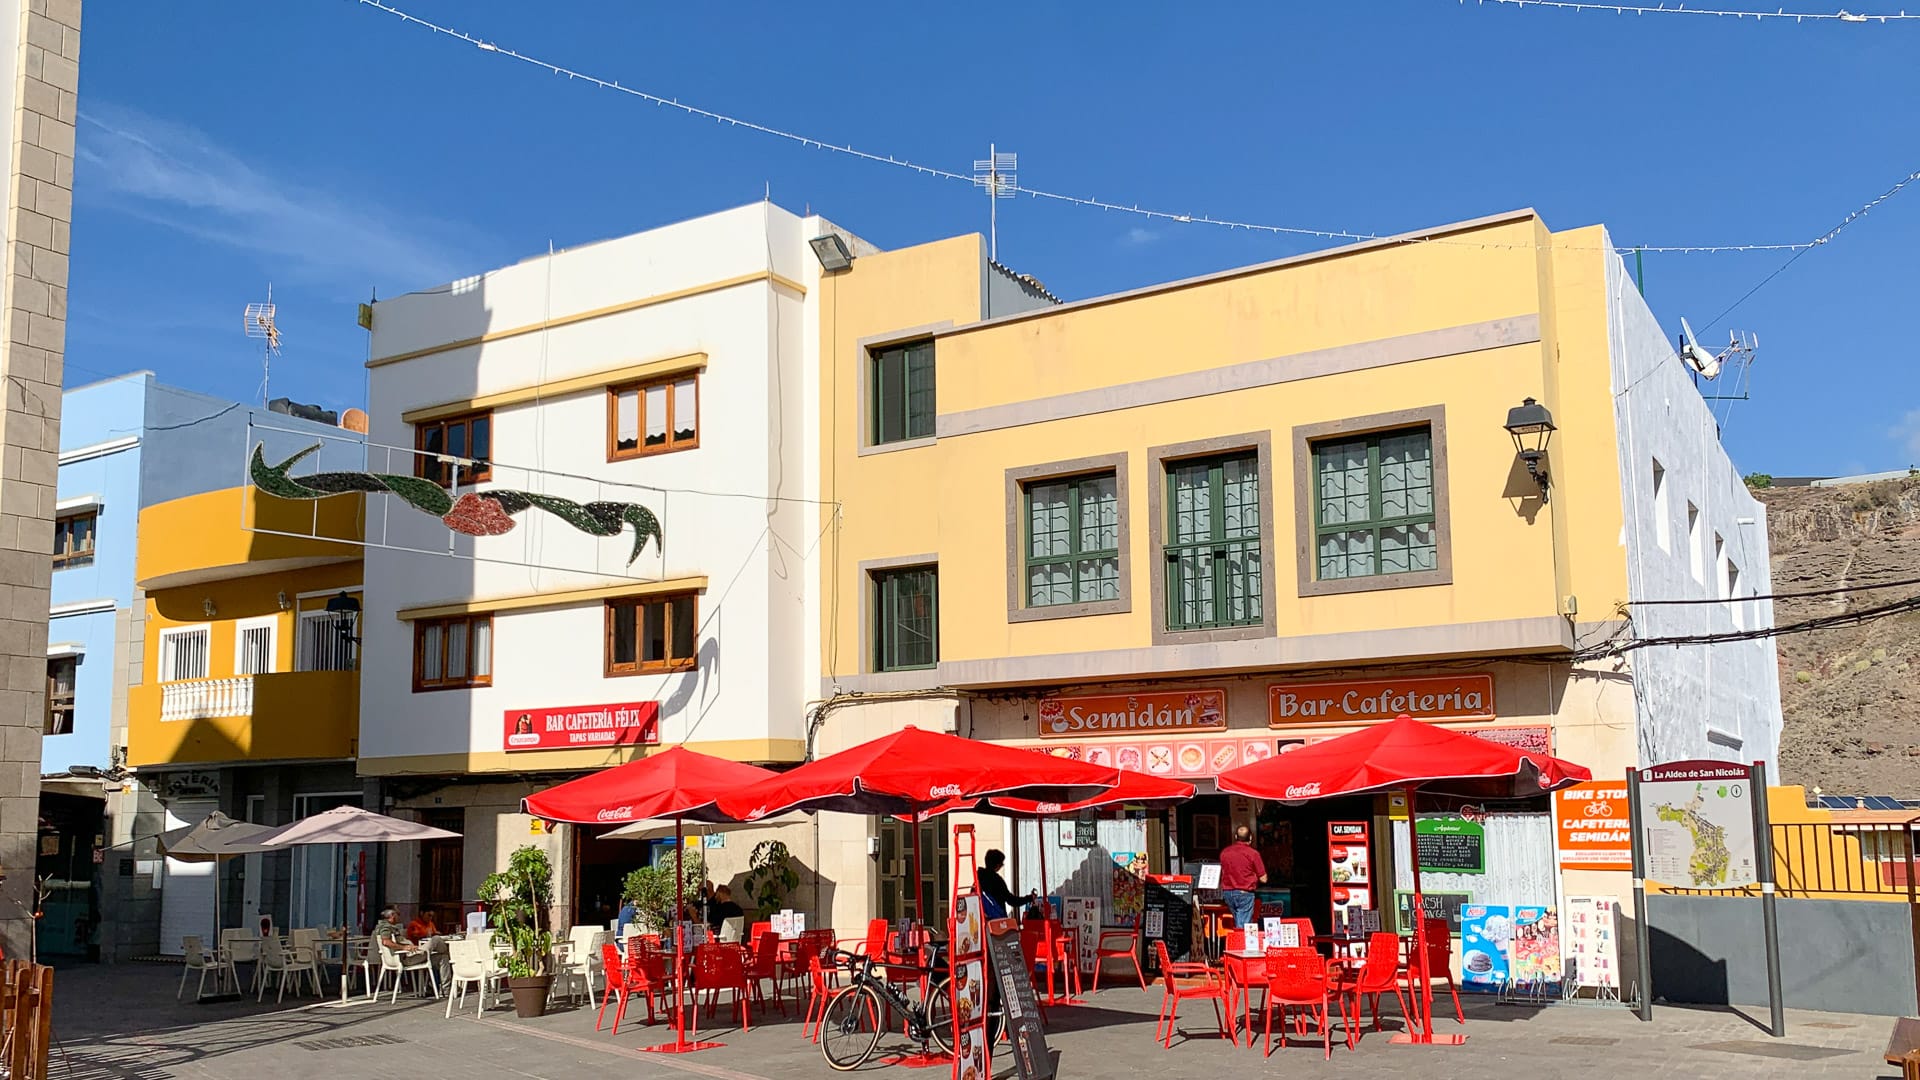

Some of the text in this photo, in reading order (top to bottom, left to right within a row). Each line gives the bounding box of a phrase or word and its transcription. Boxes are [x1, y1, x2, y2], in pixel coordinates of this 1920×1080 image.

[545, 707, 640, 731] BAR CAFETERÍA FÉLIX
[1069, 703, 1193, 730] Semidán
[569, 731, 616, 743] TAPAS VARIADAS
[1654, 768, 1745, 779] La Aldea de San Nicolás
[1285, 782, 1322, 798] Coca-Cola
[1563, 789, 1595, 800] BIKE
[597, 806, 633, 821] Coca-Cola
[1569, 829, 1631, 842] SEMIDÁN
